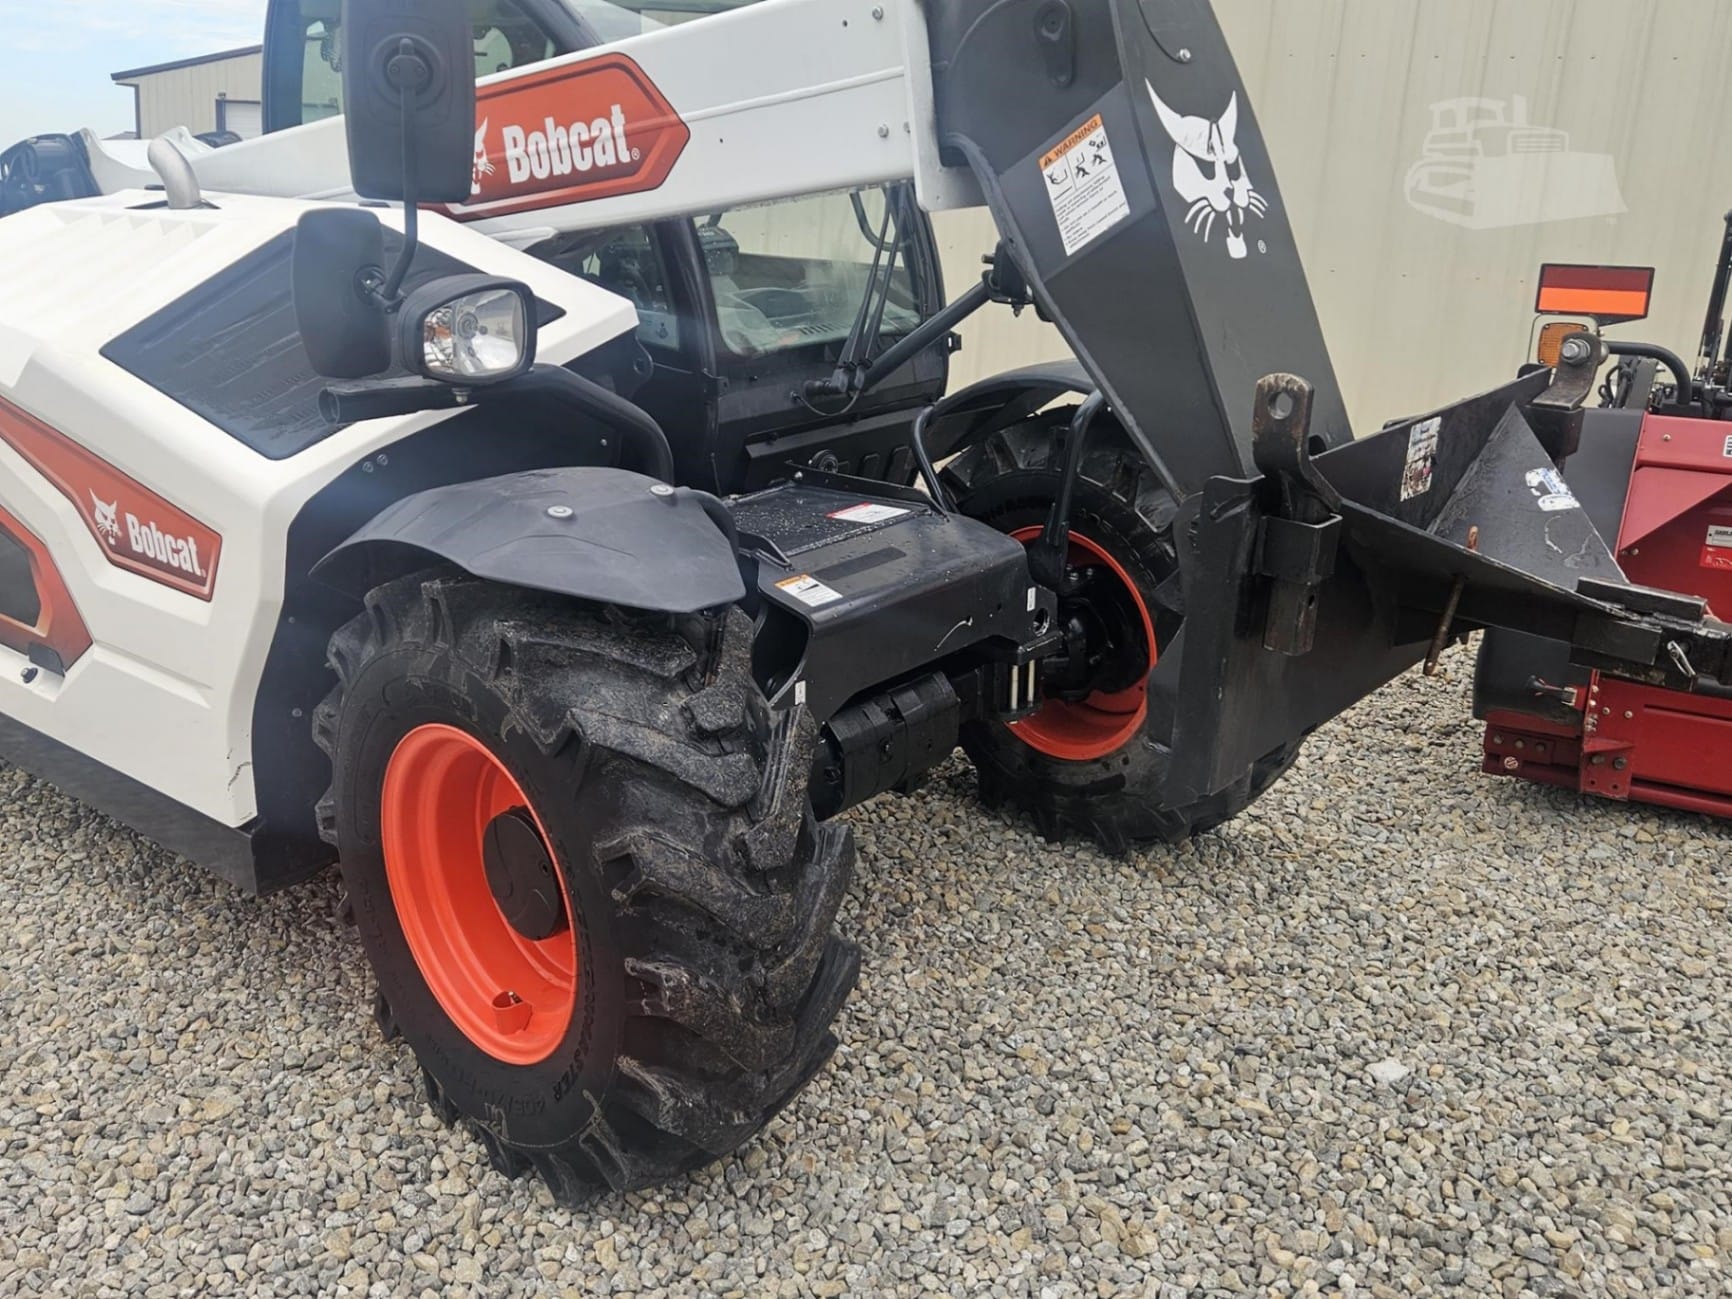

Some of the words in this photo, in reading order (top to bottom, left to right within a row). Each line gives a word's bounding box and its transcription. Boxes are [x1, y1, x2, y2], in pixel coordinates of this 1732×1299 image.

[502, 104, 631, 184] Bobcat
[1053, 118, 1099, 158] WARNING
[125, 512, 202, 577] Bobcat
